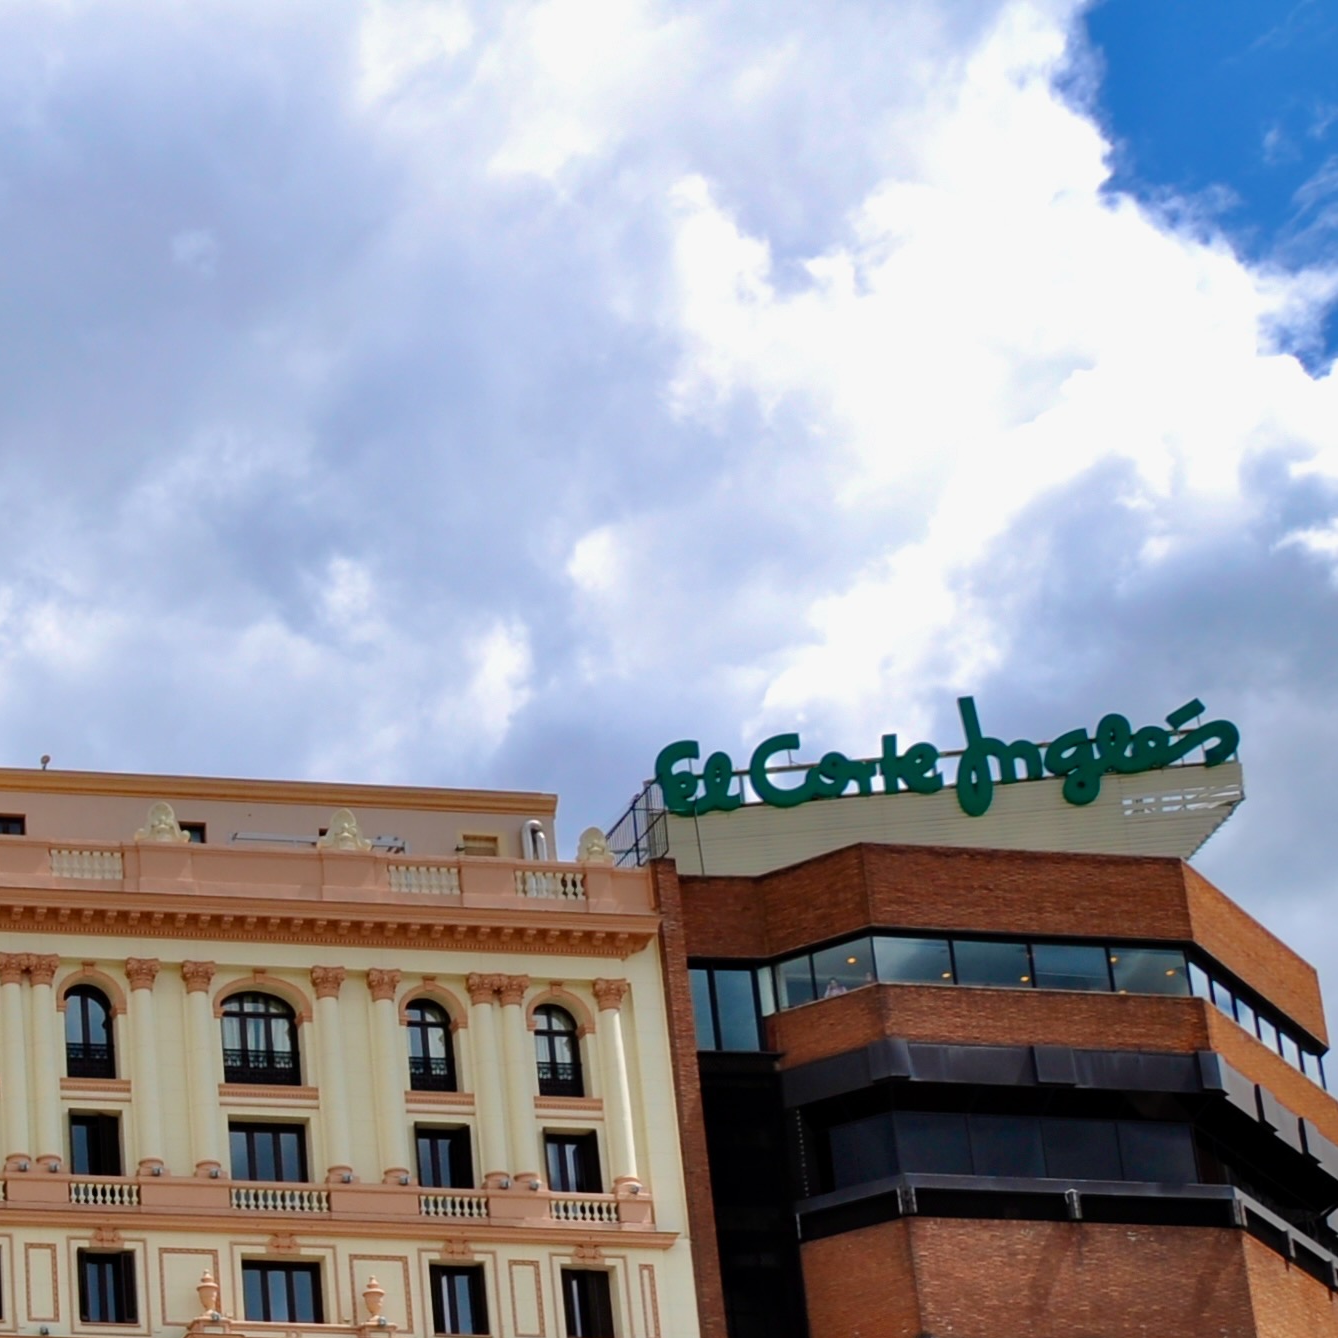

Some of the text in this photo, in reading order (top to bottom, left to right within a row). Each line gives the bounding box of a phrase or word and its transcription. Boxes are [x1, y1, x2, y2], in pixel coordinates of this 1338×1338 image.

[655, 696, 1240, 817] El Corte Inglés
